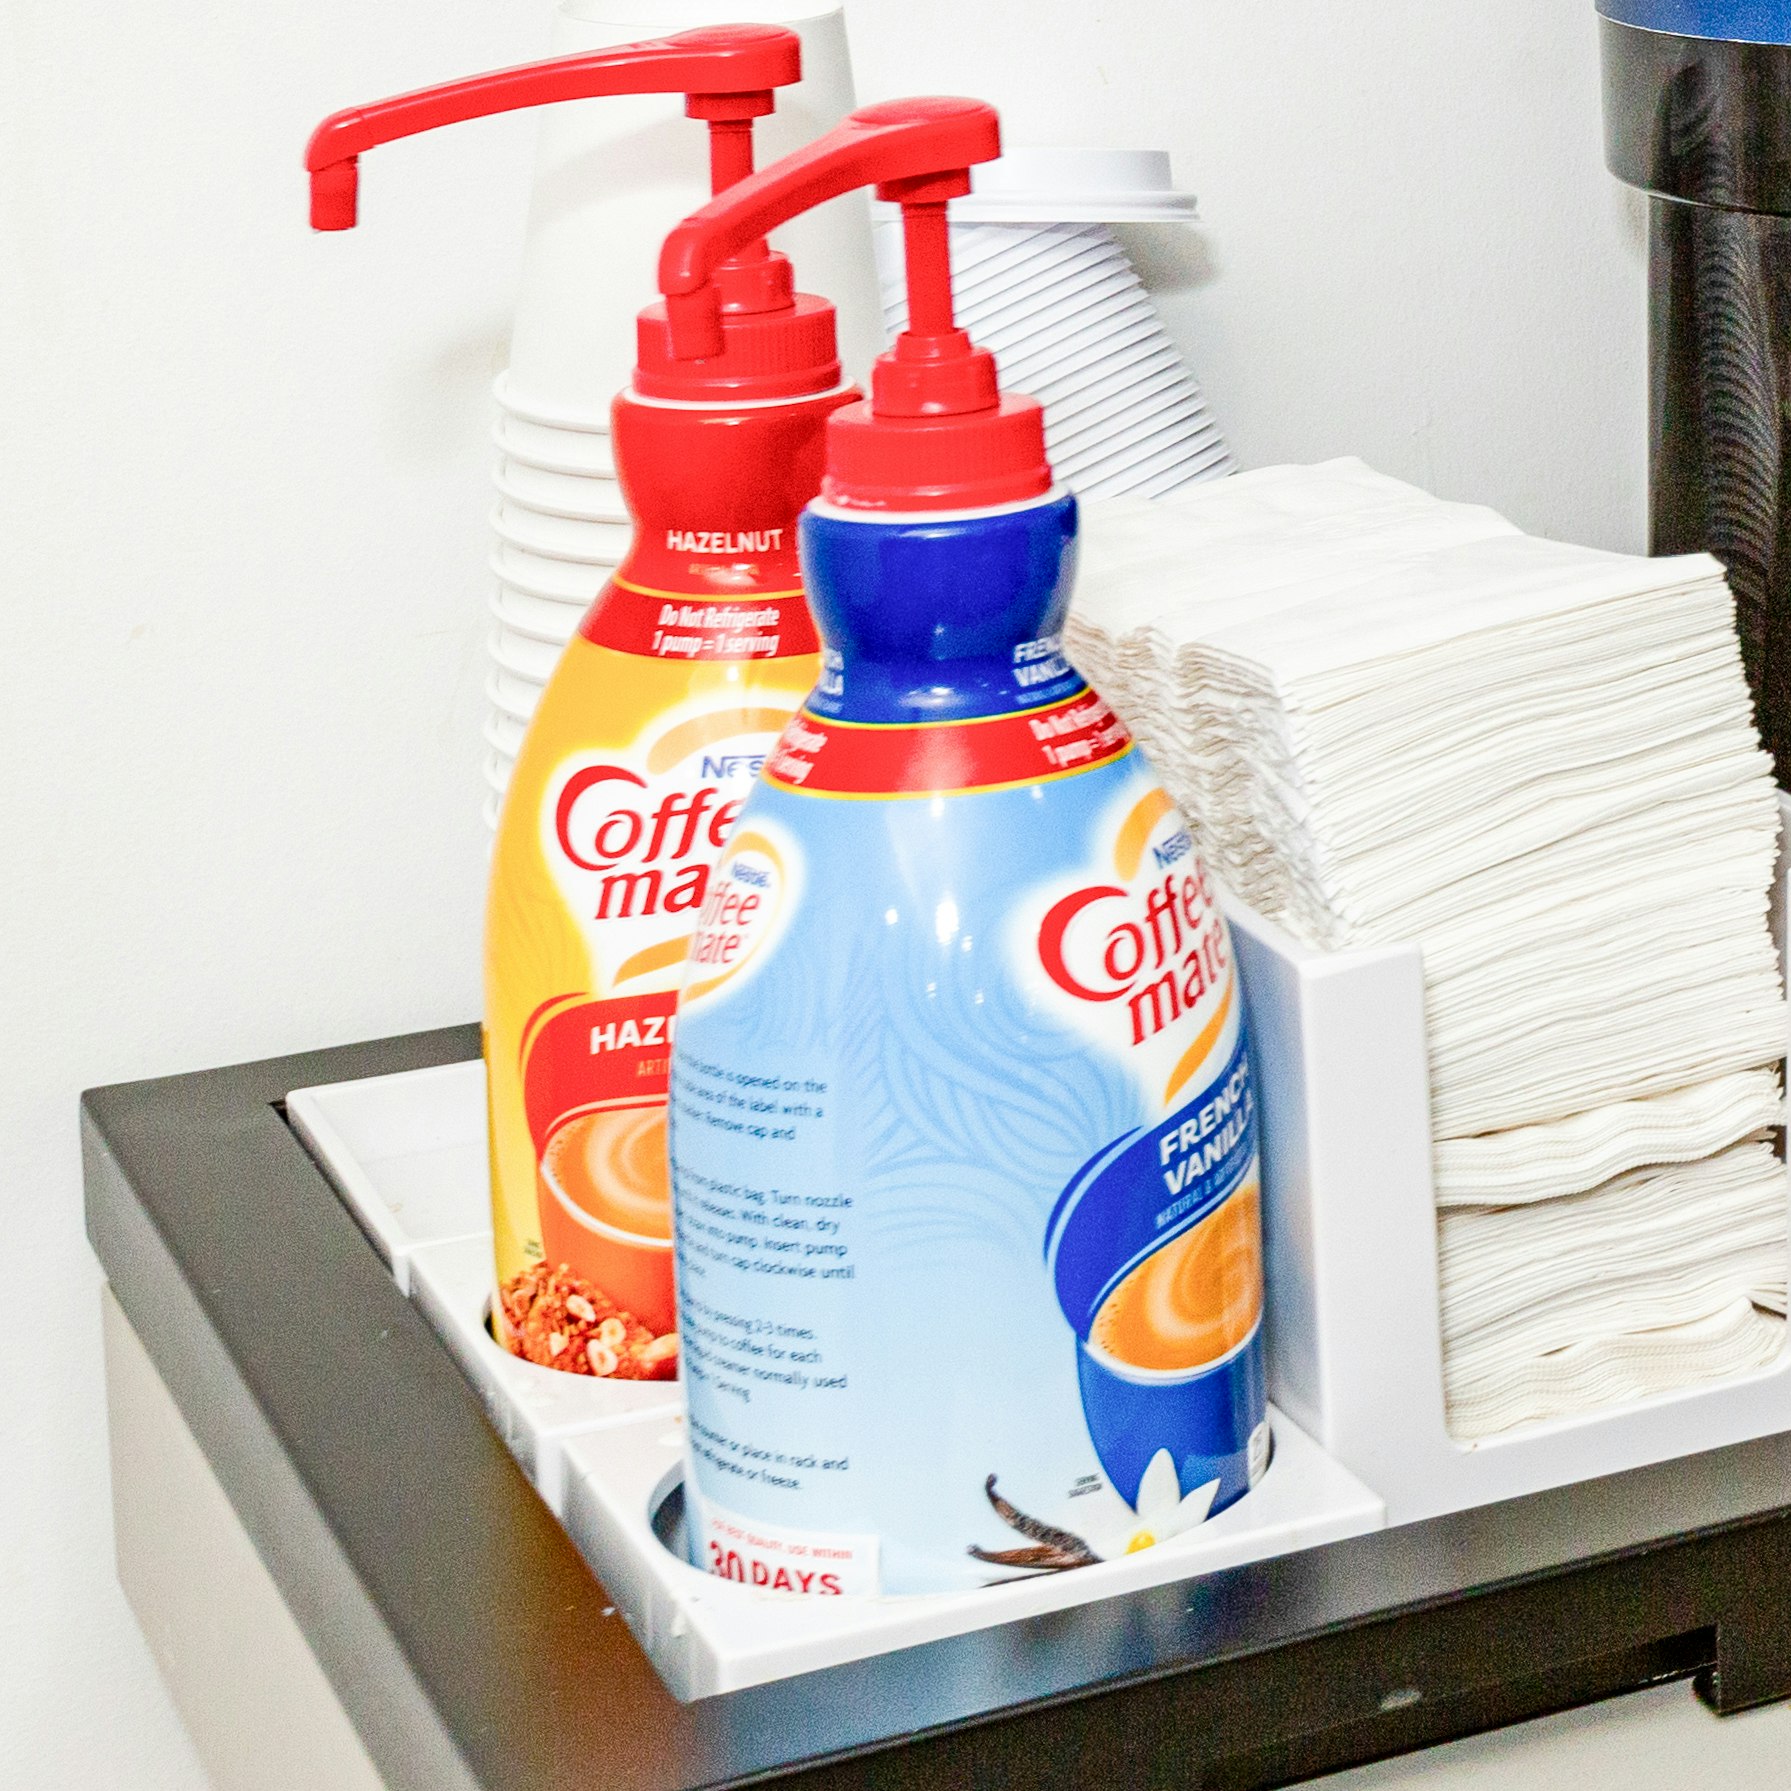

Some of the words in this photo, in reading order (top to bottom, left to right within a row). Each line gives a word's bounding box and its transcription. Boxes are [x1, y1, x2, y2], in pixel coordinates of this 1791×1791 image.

[667, 528, 783, 555] HAZELNUT
[658, 603, 679, 627] Do
[703, 605, 780, 635] Refrigerate
[652, 629, 664, 651] 1
[659, 634, 704, 659] pump
[725, 629, 780, 658] serving
[1127, 916, 1228, 1046] mate
[803, 1077, 829, 1095] the
[783, 1101, 813, 1118] with
[771, 1124, 797, 1142] and
[770, 1188, 802, 1206] Turn
[804, 1193, 856, 1209] nozzle
[815, 1214, 841, 1237] dry
[804, 1242, 850, 1258] pump
[752, 1257, 818, 1279] clockwise
[820, 1262, 857, 1280] until
[790, 1348, 823, 1365] each
[813, 1372, 849, 1390] used
[821, 1455, 851, 1472] and
[751, 1559, 844, 1597] DAYS
